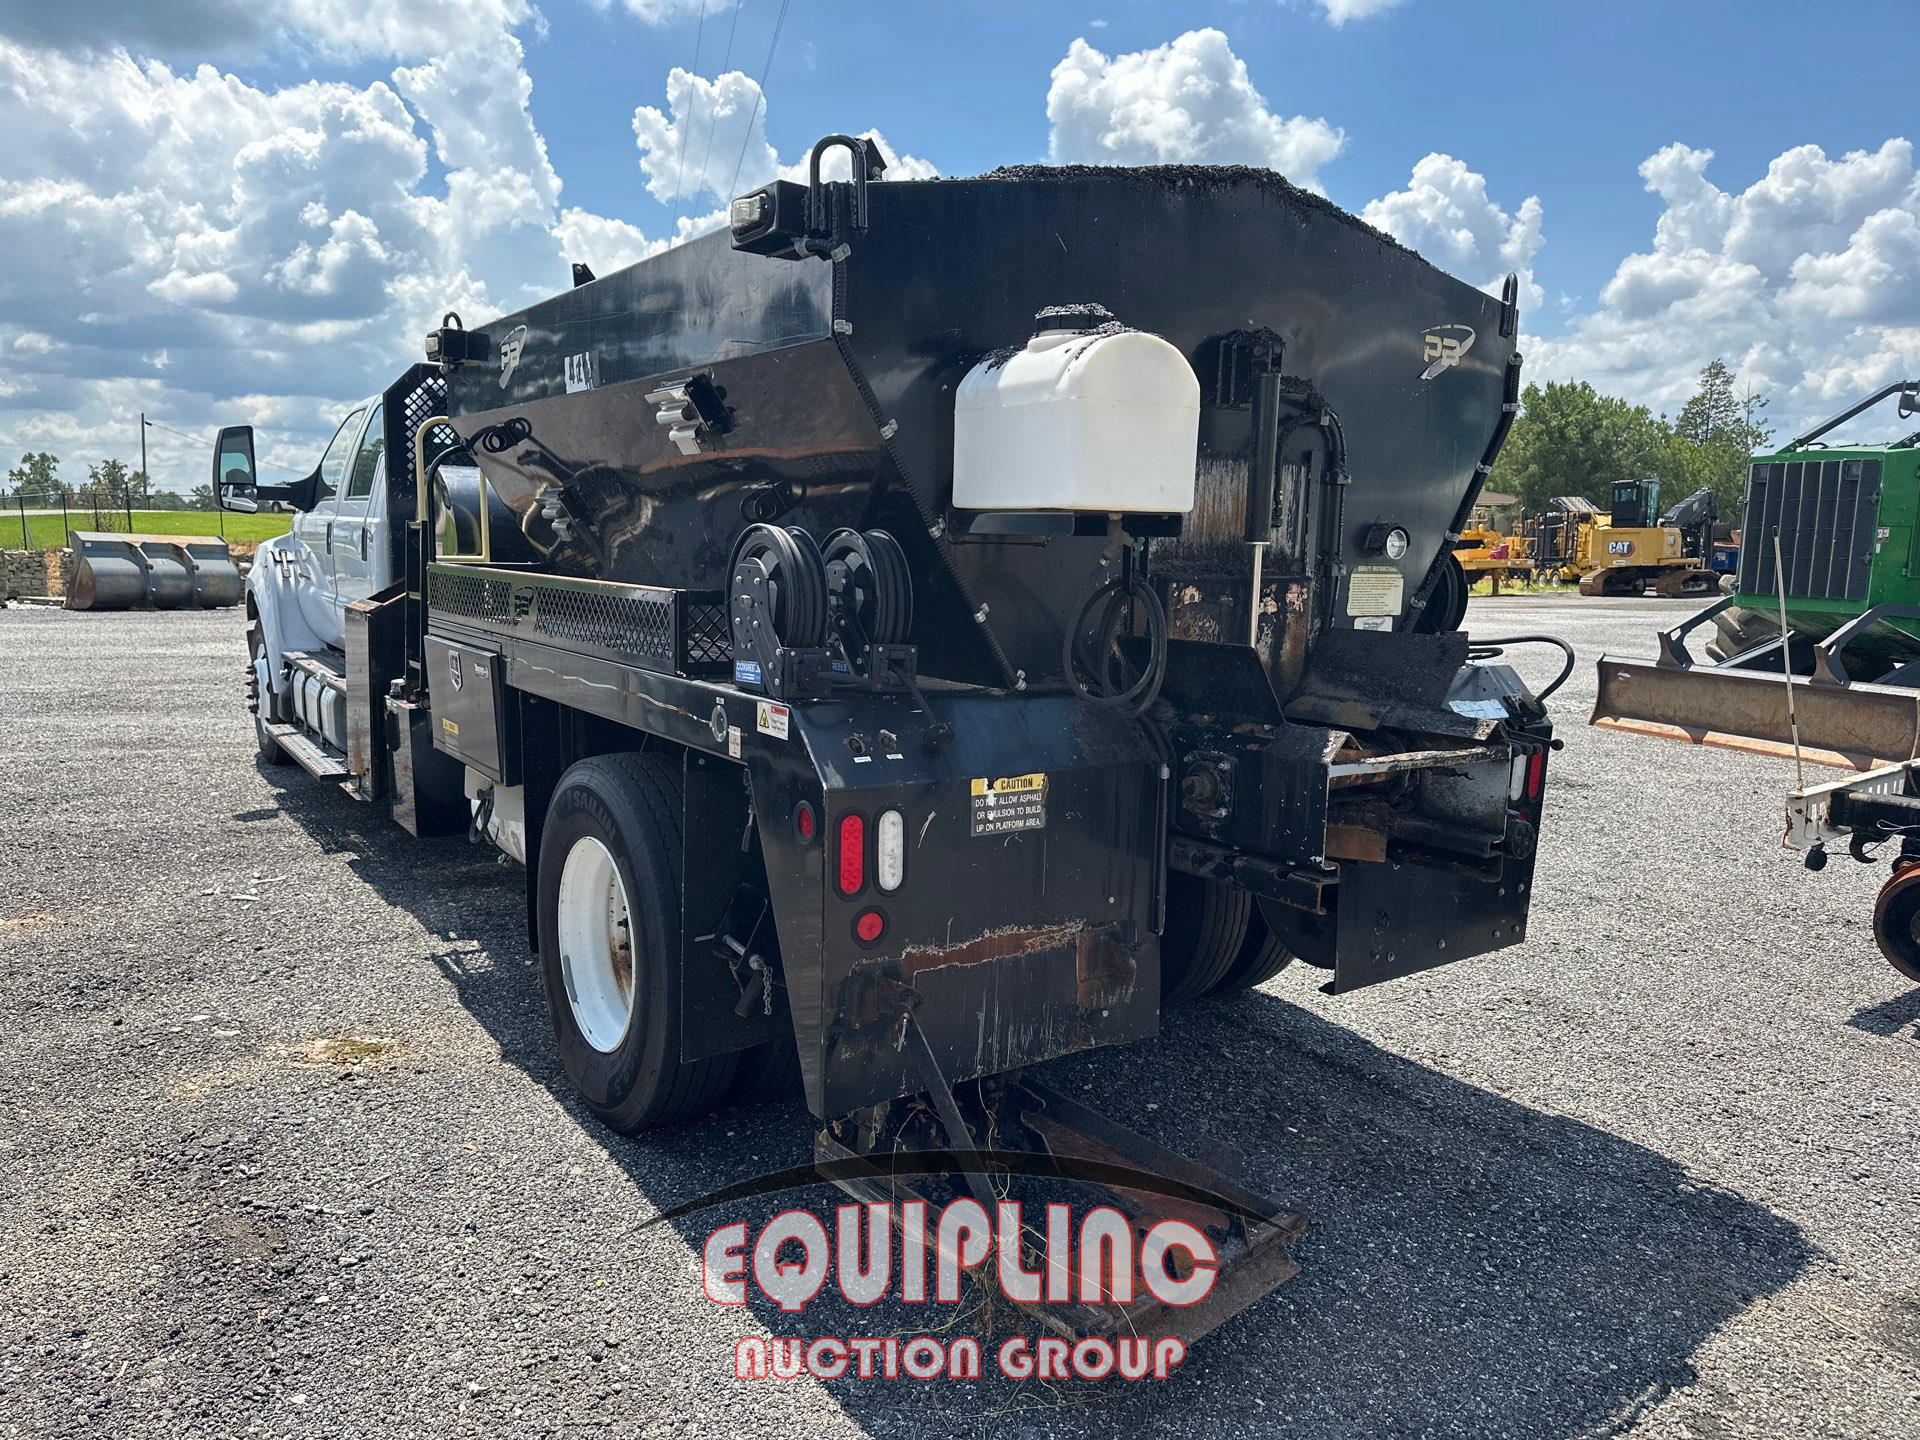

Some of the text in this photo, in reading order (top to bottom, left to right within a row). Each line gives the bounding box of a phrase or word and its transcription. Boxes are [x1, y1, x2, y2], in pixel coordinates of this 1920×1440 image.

[1608, 541, 1630, 554] CAT
[1001, 777, 1033, 790] CAUTION
[975, 798, 985, 808] DO
[986, 796, 998, 807] NT
[998, 794, 1019, 805] ALLOW
[976, 811, 986, 820] OR
[1016, 807, 1024, 815] TO
[1025, 805, 1041, 814] BUILD
[976, 824, 985, 833] UP
[985, 822, 995, 832] ON
[995, 819, 1024, 830] PLATFORM
